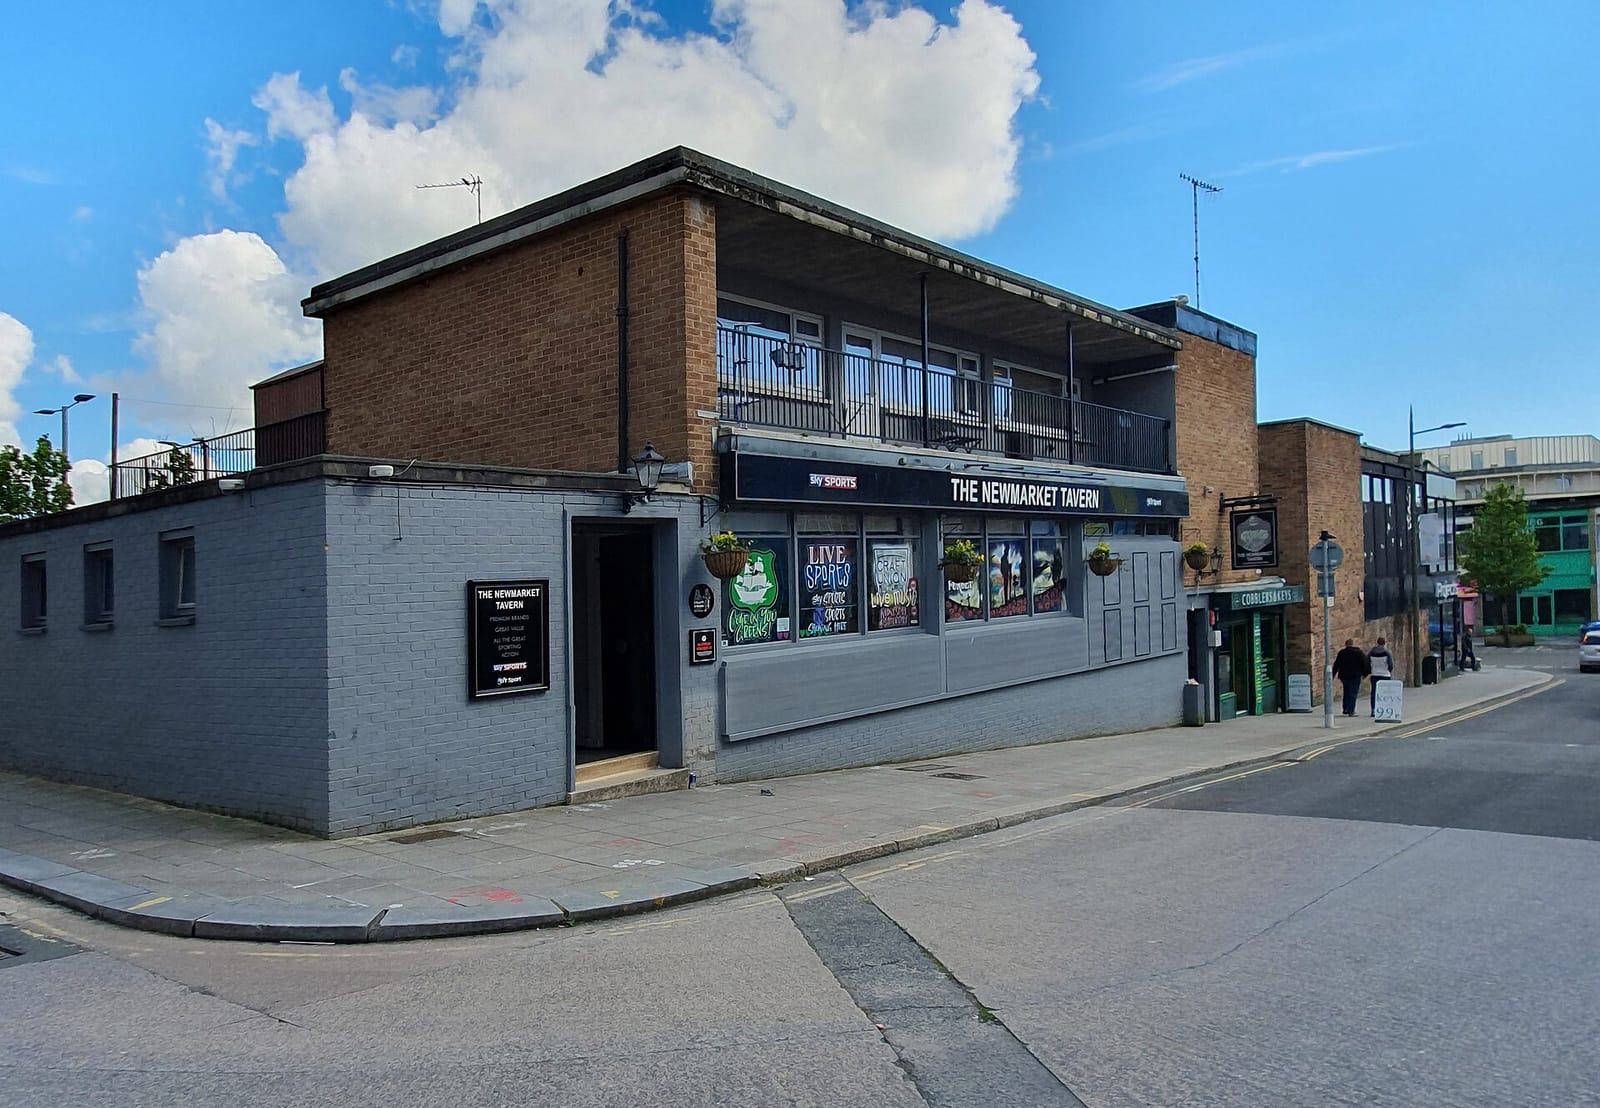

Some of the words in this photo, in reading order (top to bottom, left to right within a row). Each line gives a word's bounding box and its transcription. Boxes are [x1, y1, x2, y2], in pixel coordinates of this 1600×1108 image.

[810, 475, 822, 487] sky
[824, 476, 857, 488] SPORTS
[951, 478, 978, 502] THE
[982, 480, 1058, 507] NEWMARKET
[1060, 487, 1100, 509] TAVERN
[809, 545, 846, 565] LIVE
[876, 559, 906, 572] CRAFT
[877, 572, 907, 585] UNION
[478, 590, 493, 599] THE
[494, 588, 540, 599] NEWMARKET
[823, 591, 846, 605] SPORTS
[495, 600, 524, 610] TAVERN
[825, 608, 846, 622] SPORTS
[503, 661, 528, 671] SPORTS
